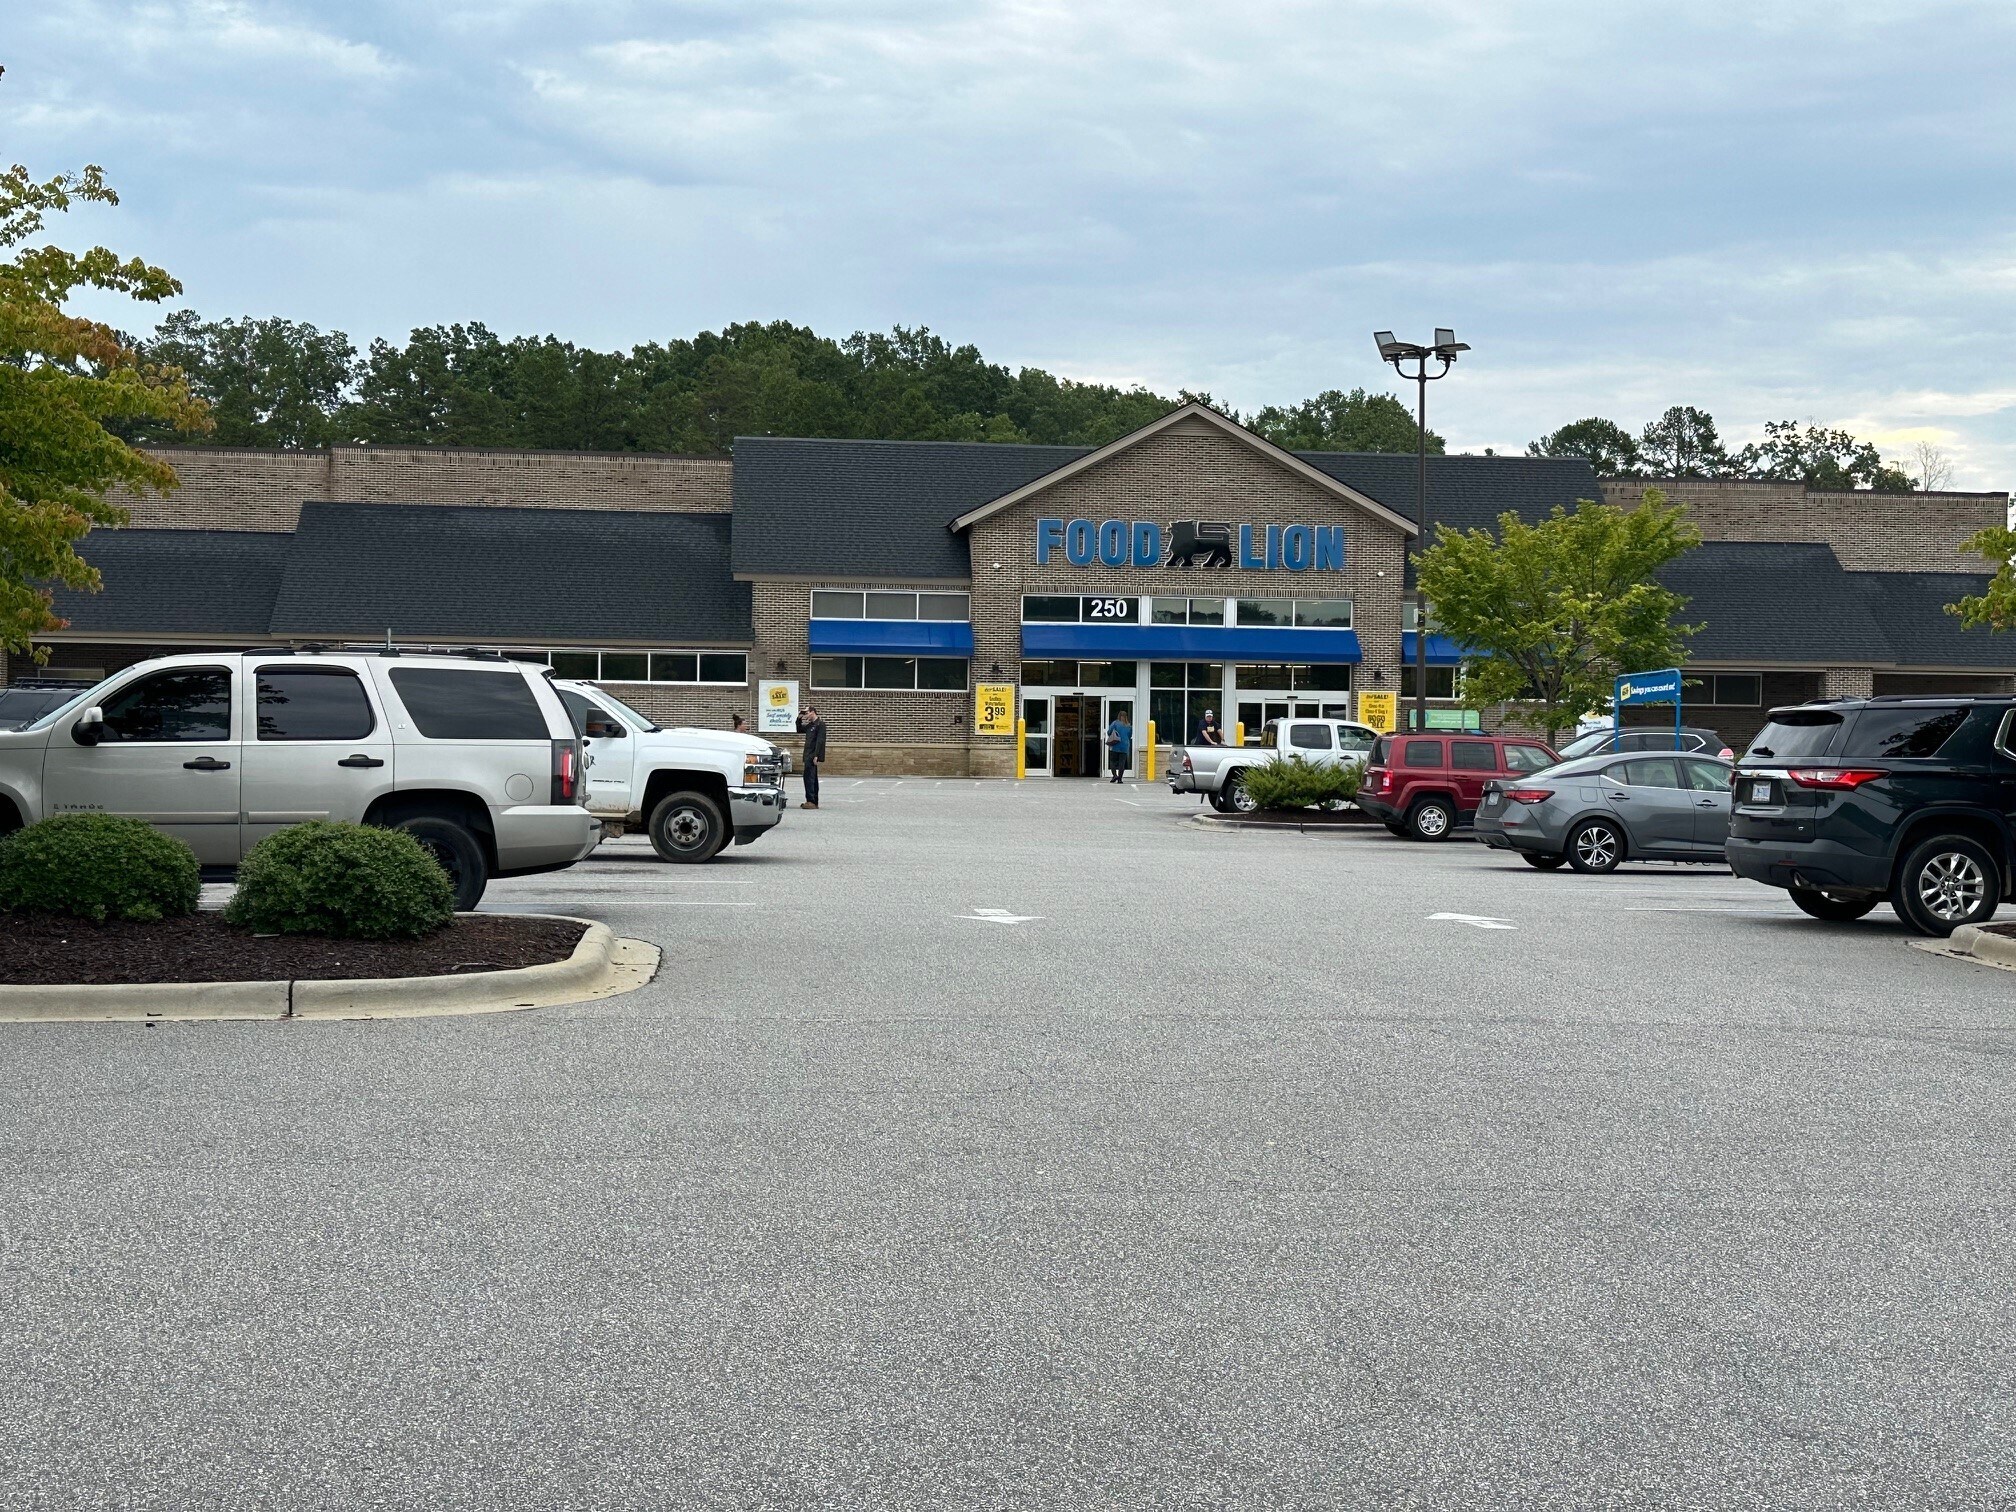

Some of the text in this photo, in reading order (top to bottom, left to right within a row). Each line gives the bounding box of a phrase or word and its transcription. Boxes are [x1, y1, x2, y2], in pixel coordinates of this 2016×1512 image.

[1036, 518, 1345, 571] FOOD LION
[1090, 598, 1128, 618] 250
